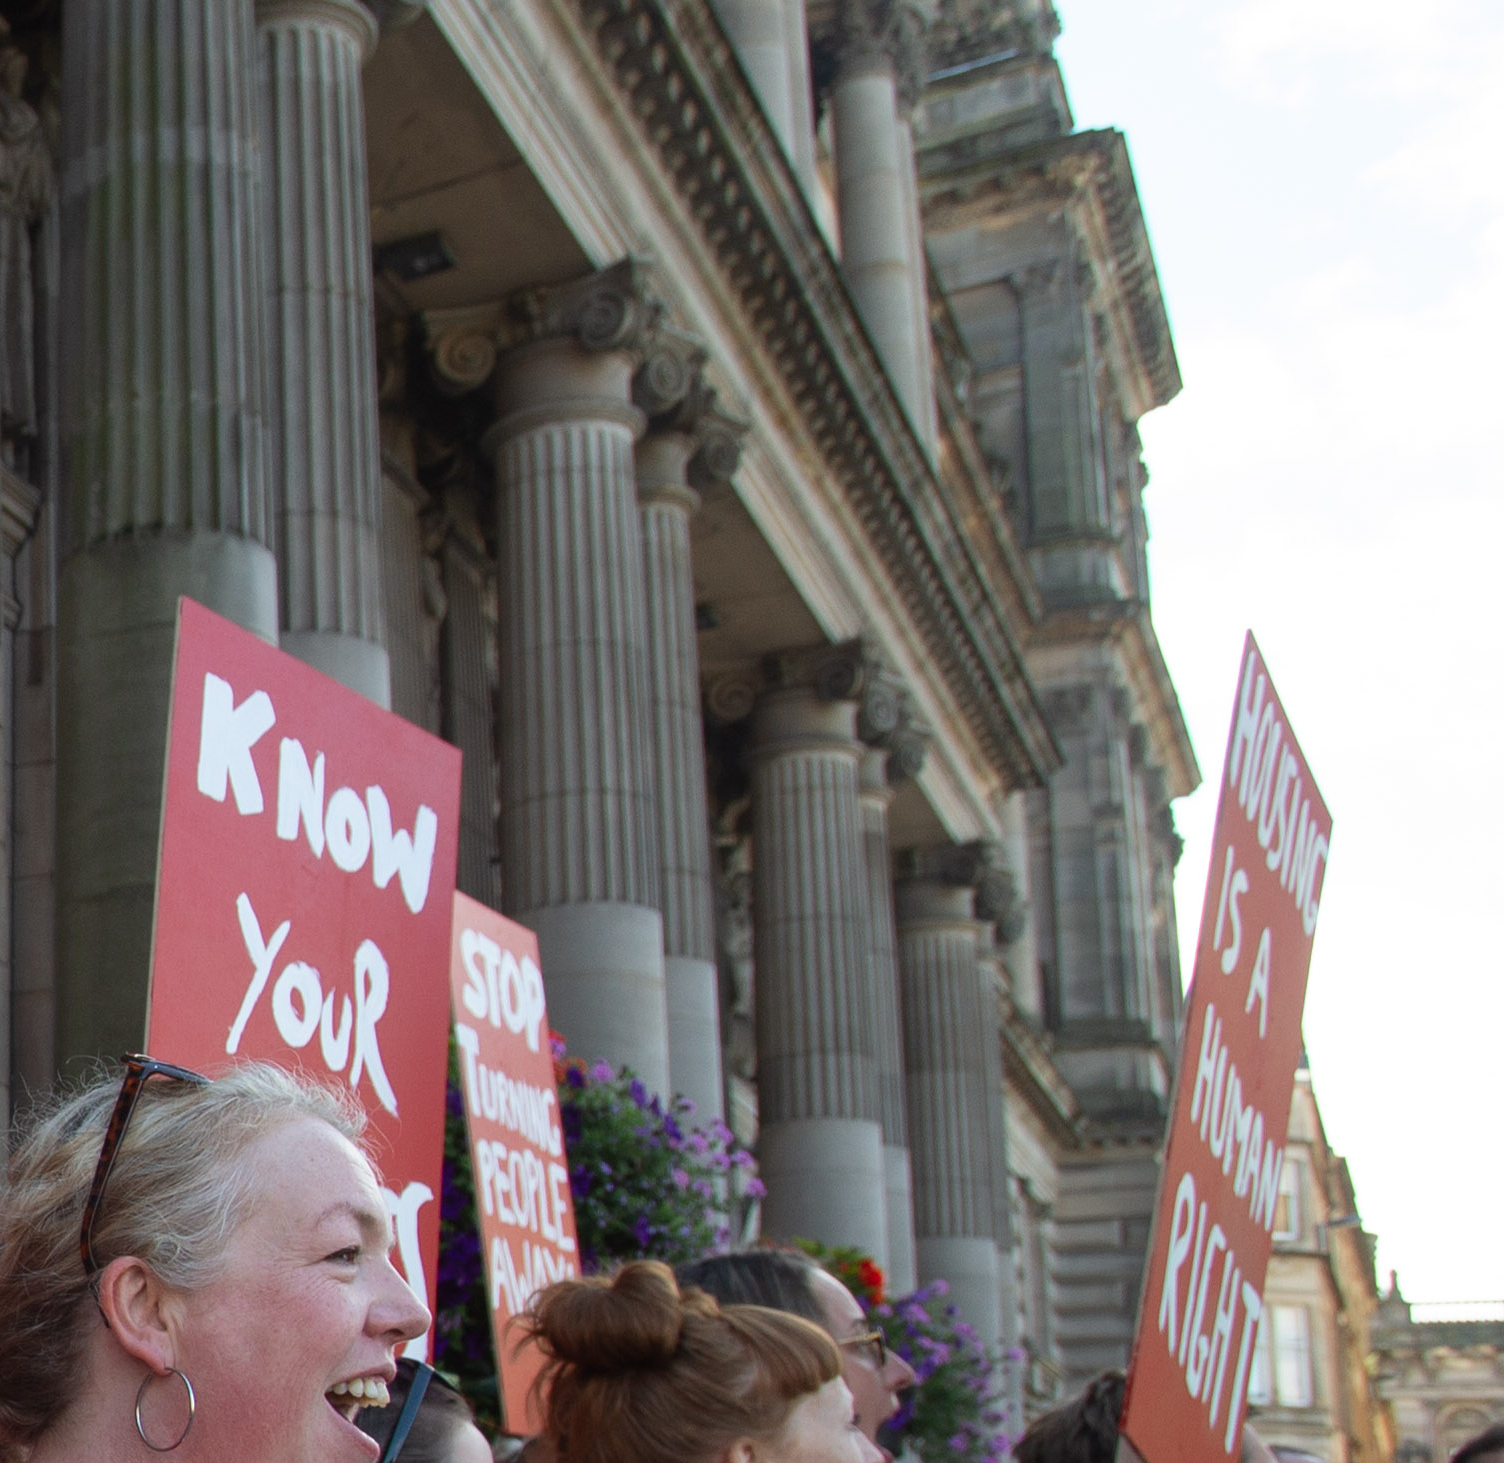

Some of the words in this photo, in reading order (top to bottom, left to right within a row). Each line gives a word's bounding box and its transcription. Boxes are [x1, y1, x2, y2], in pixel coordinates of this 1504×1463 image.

[196, 671, 438, 914] KNOW
[1230, 650, 1329, 937] HOUSING
[459, 927, 546, 1053] STOP
[1212, 844, 1249, 975] IS
[1245, 926, 1271, 1039] A
[454, 1021, 563, 1158] TURNING
[476, 1137, 576, 1252] PEOPLE
[1190, 1002, 1284, 1232] HUMAN
[1158, 1171, 1262, 1455] RIGHT
